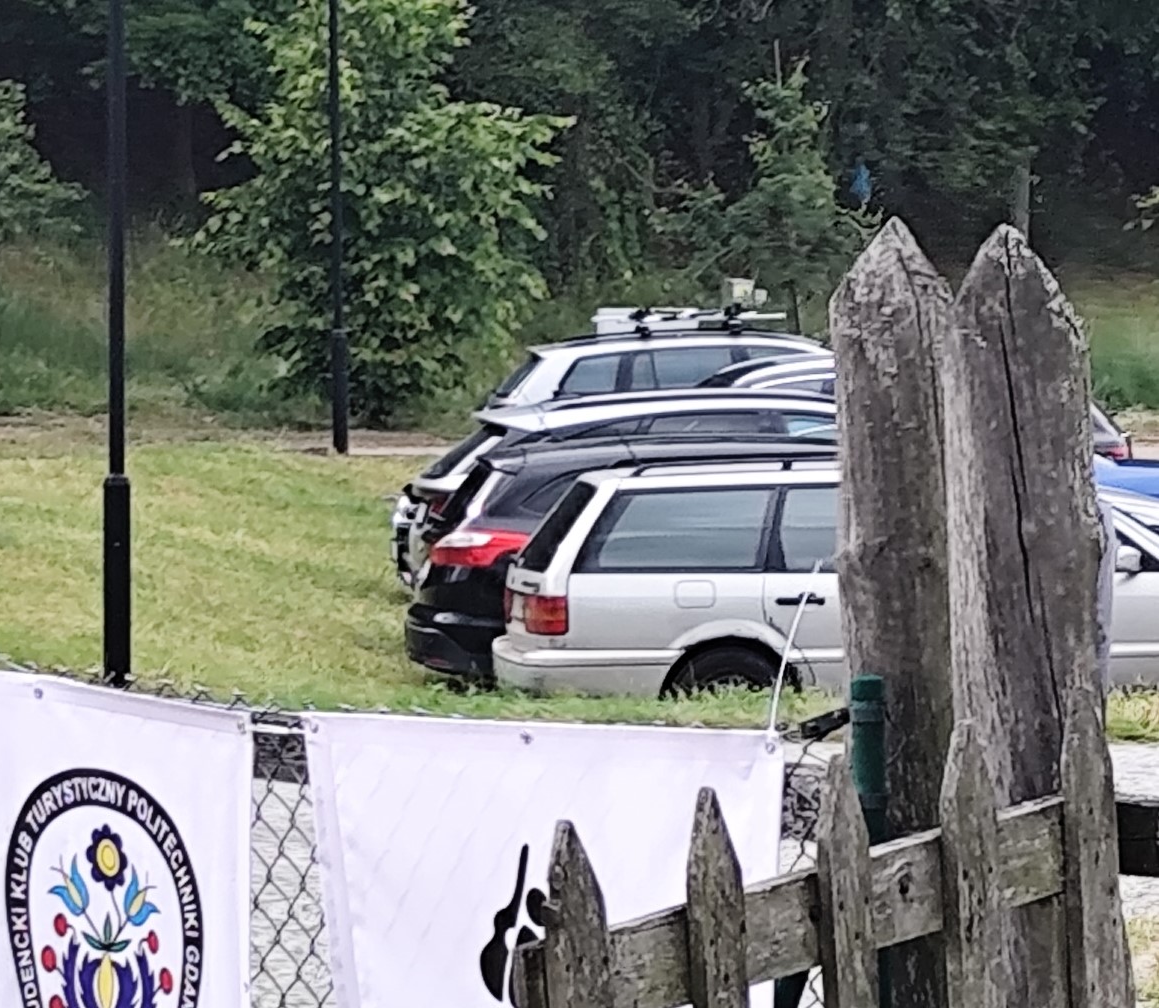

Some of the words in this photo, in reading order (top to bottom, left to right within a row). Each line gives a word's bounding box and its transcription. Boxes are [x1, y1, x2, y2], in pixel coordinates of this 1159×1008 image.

[10, 833, 33, 901] KLUB
[24, 776, 126, 833] TURYSTYCZNY
[126, 789, 200, 939] POLITECHNIKI
